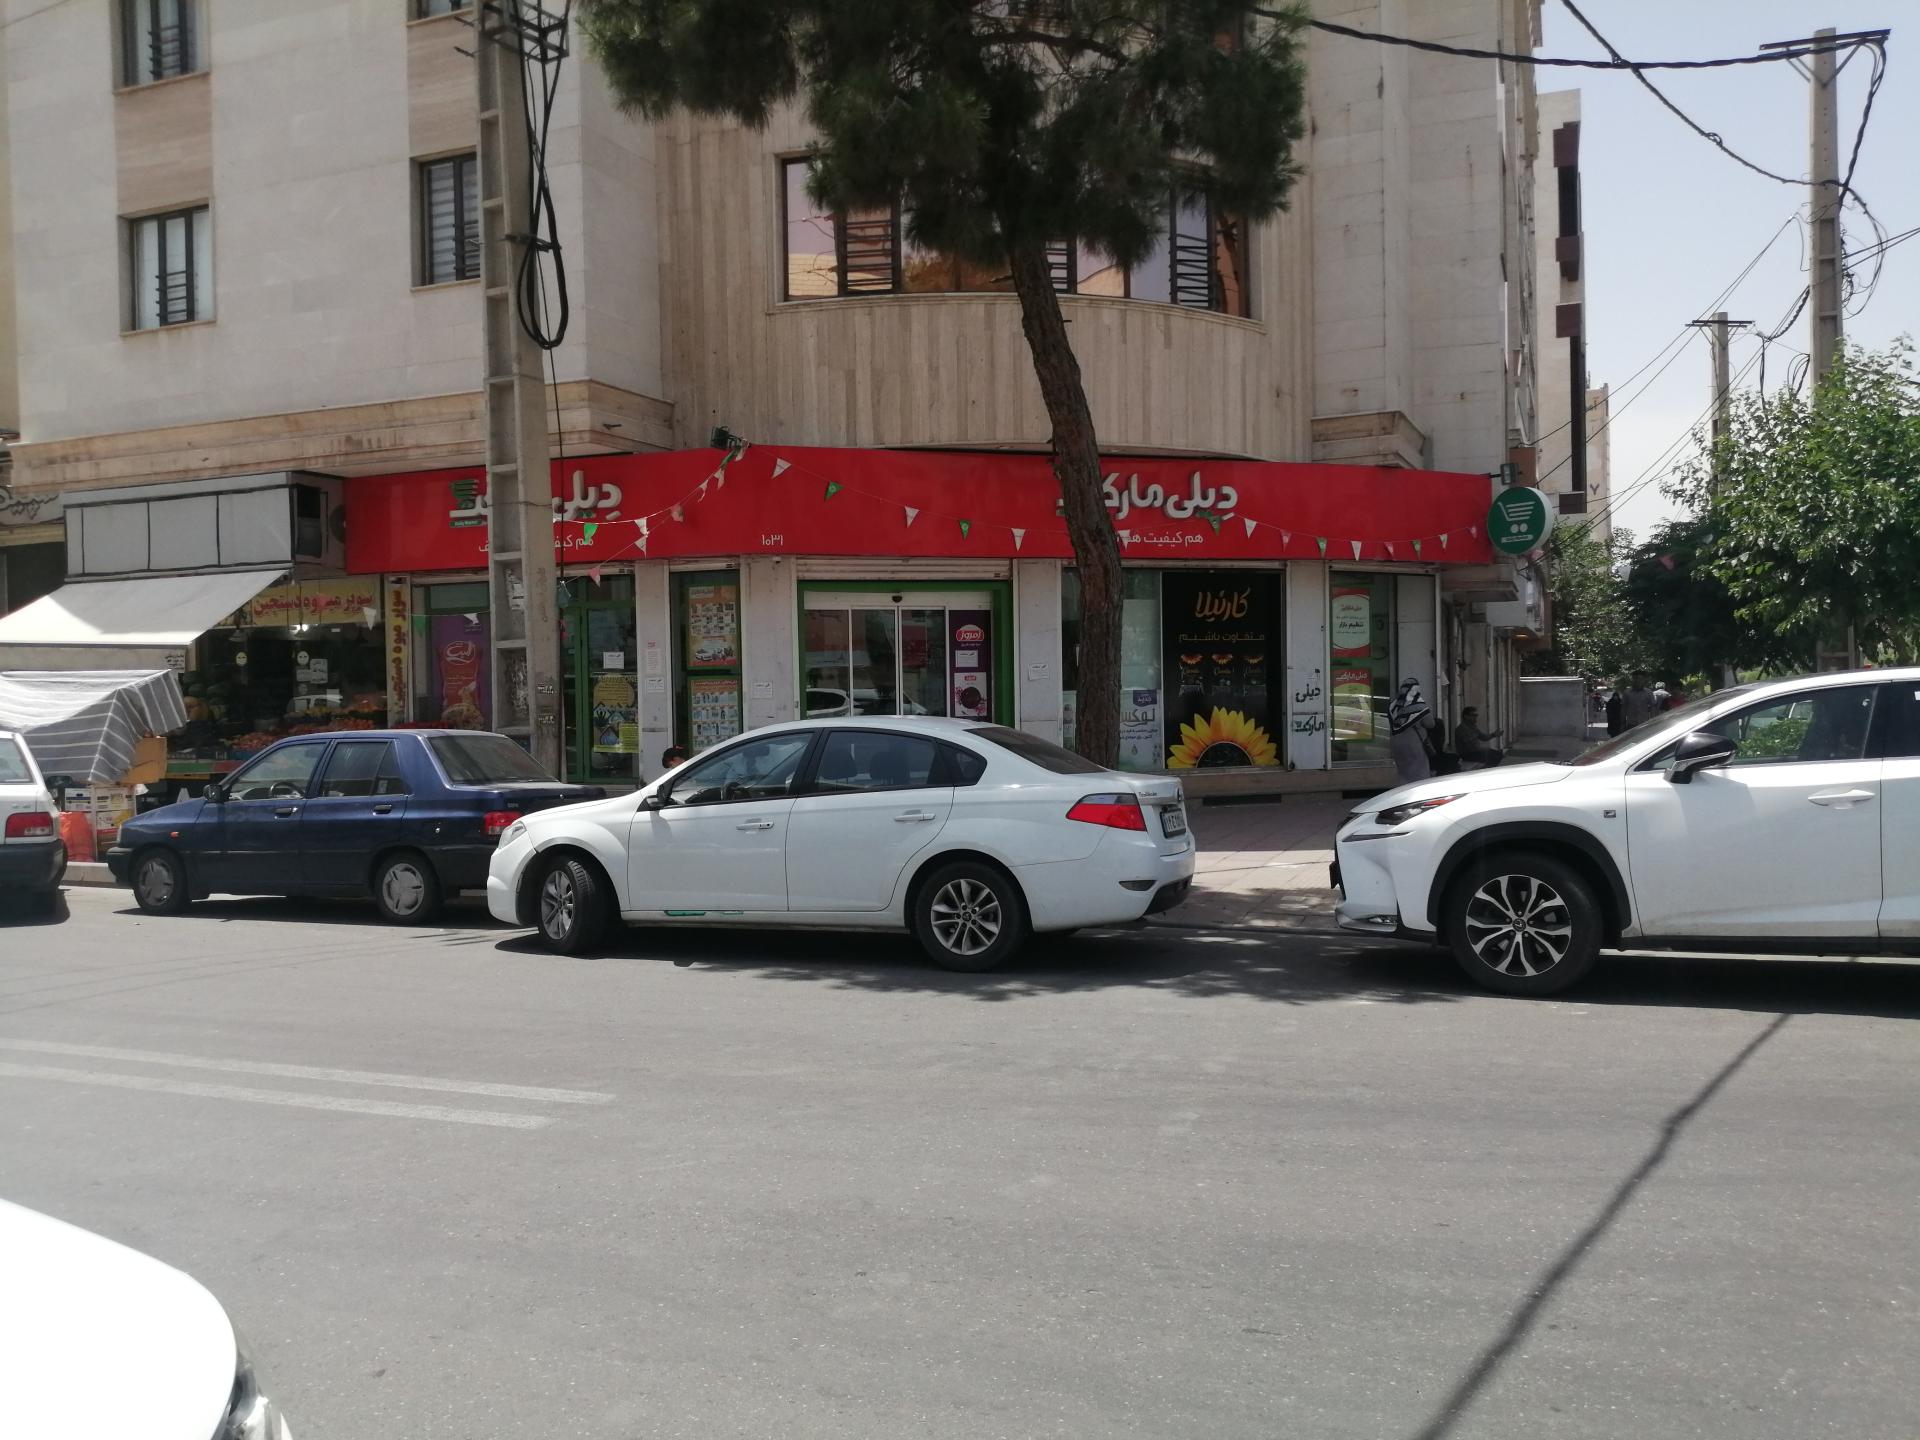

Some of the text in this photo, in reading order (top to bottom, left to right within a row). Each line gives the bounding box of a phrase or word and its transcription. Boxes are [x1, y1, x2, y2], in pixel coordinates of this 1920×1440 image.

[1056, 472, 1239, 520] دیلی مارک
[1143, 531, 1183, 547] کیفیت
[1184, 533, 1203, 547] هم
[1296, 683, 1321, 703] دیلی
